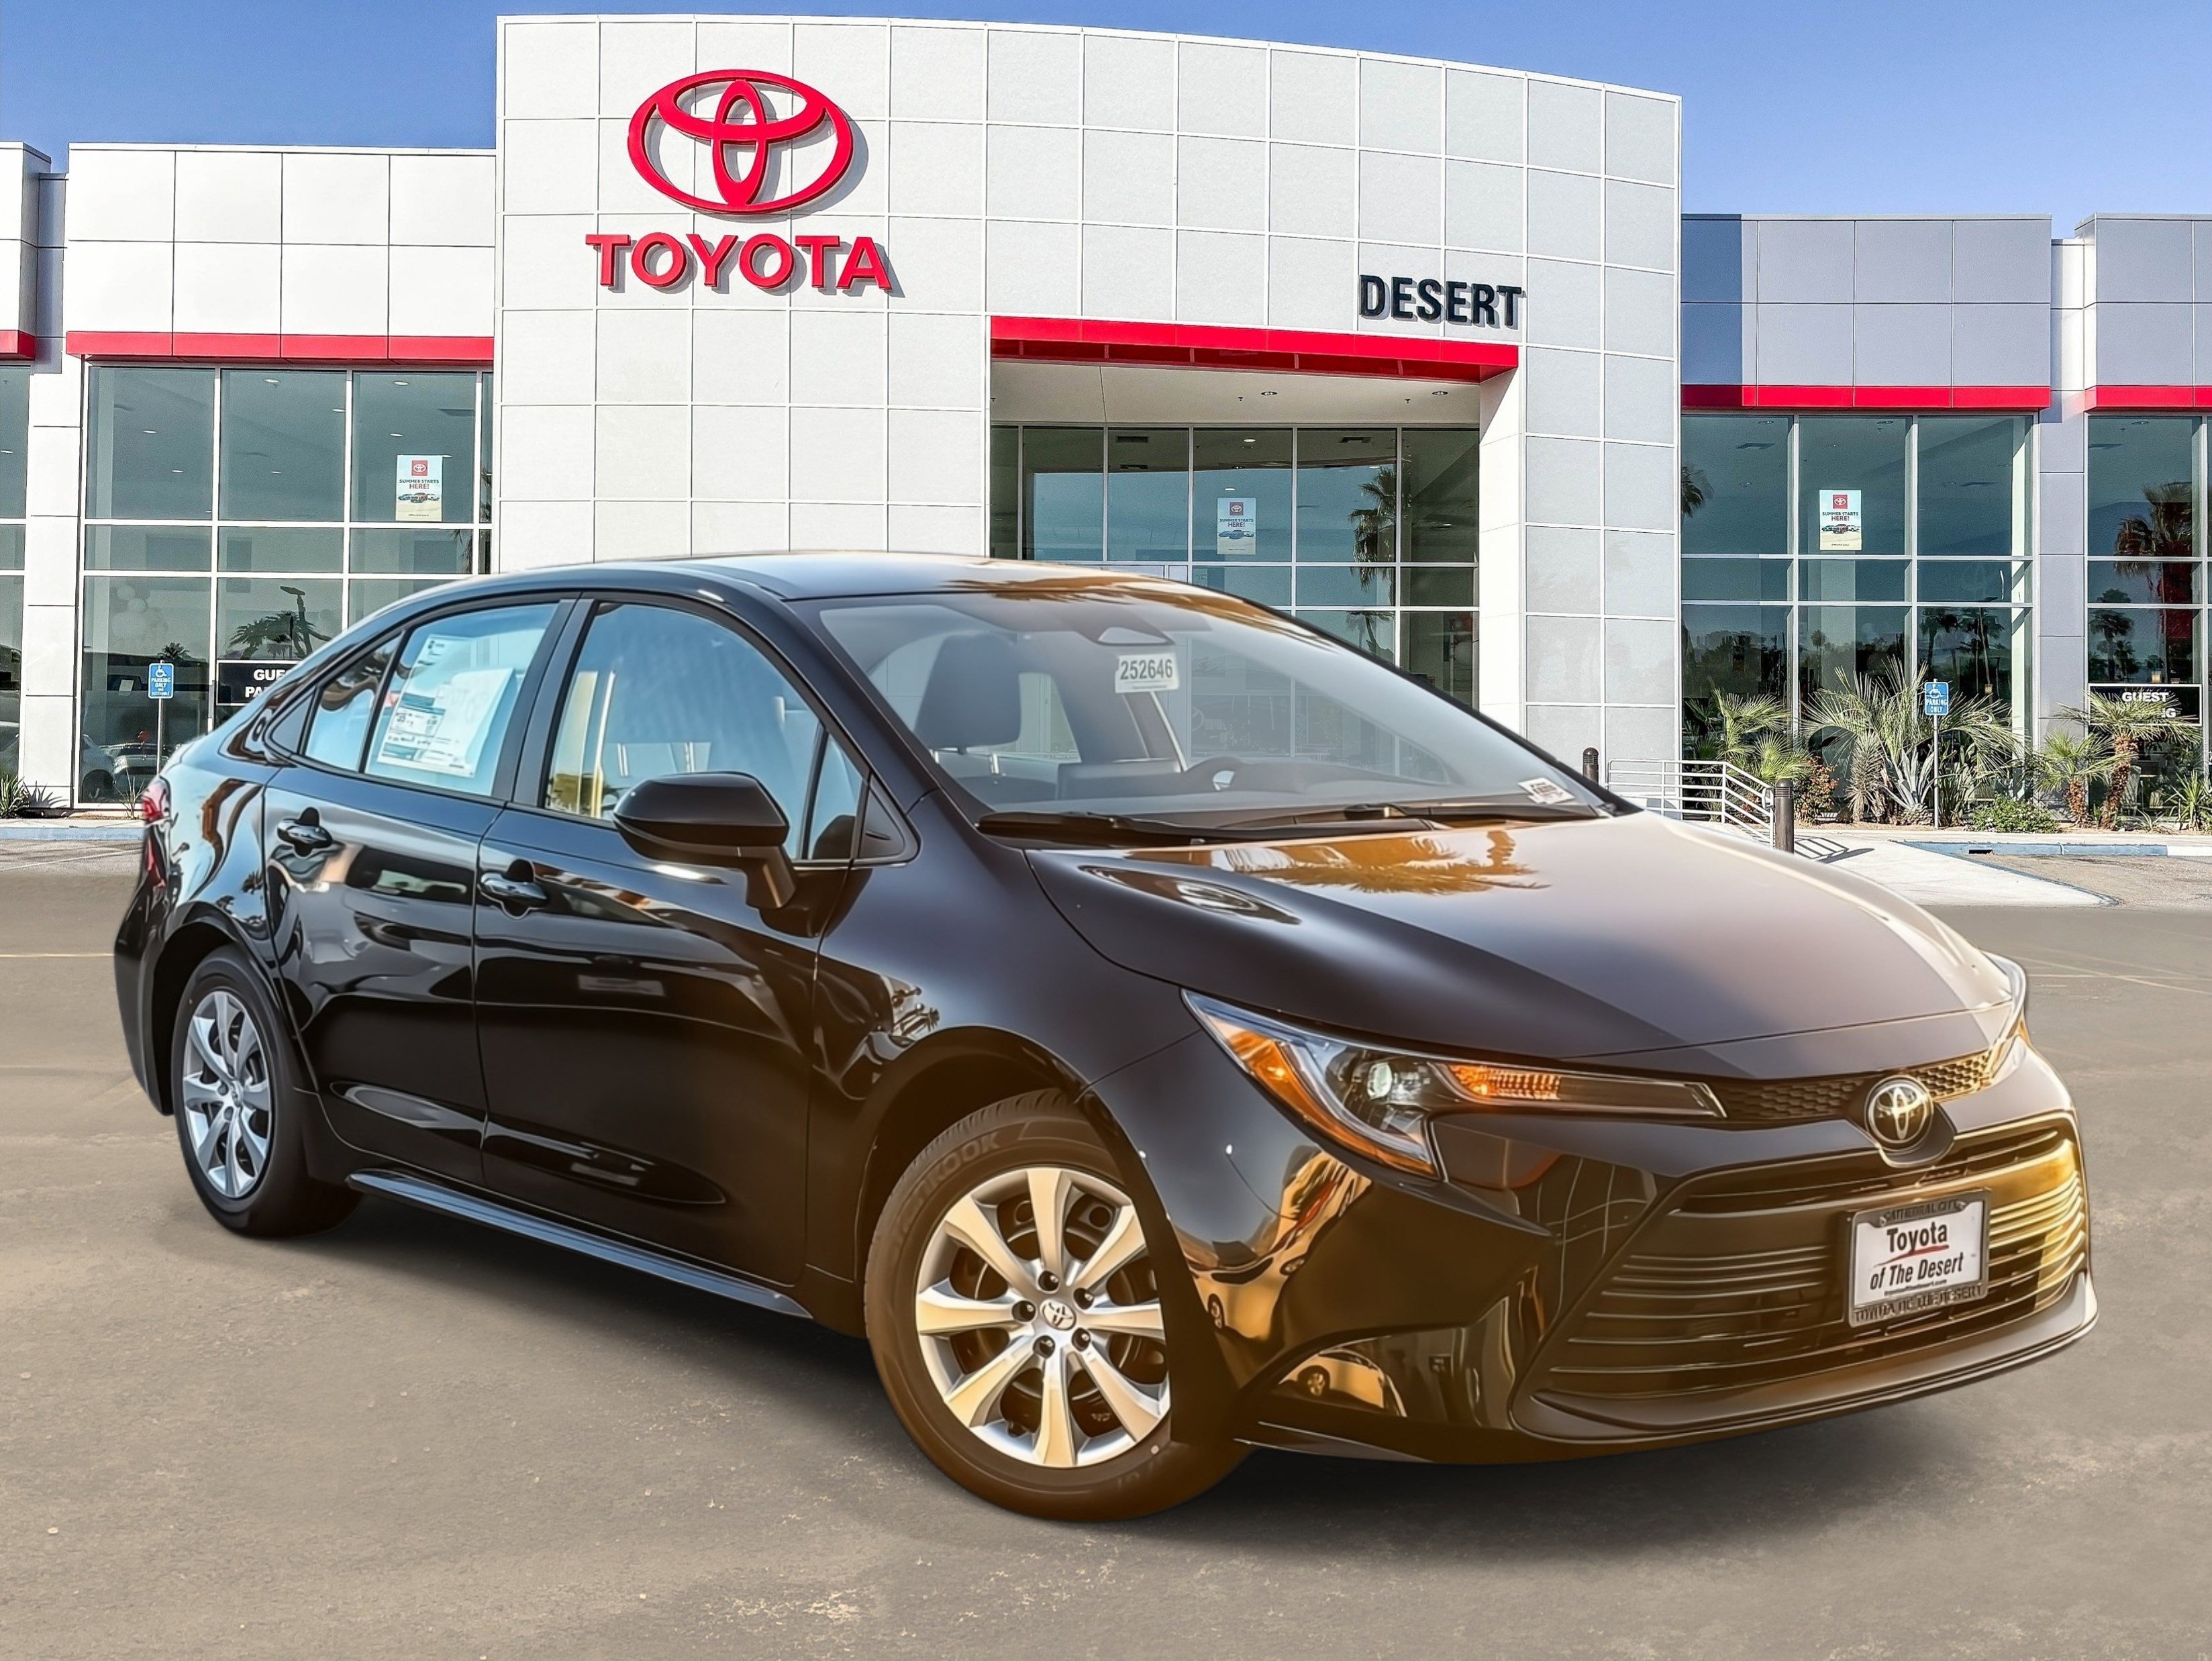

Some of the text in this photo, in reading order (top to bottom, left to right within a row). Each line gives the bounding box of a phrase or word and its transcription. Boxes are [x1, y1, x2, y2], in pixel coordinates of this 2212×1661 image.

[585, 232, 892, 291] TOYOTA
[1359, 274, 1522, 327] DESERT
[253, 669, 287, 681] GUE
[1120, 659, 1172, 680] 252646
[2121, 691, 2170, 703] GUEST
[1887, 1221, 1948, 1253] Toyota
[1870, 1268, 1885, 1291] of
[1889, 1264, 1913, 1287] The
[1917, 1252, 1964, 1280] Desert
